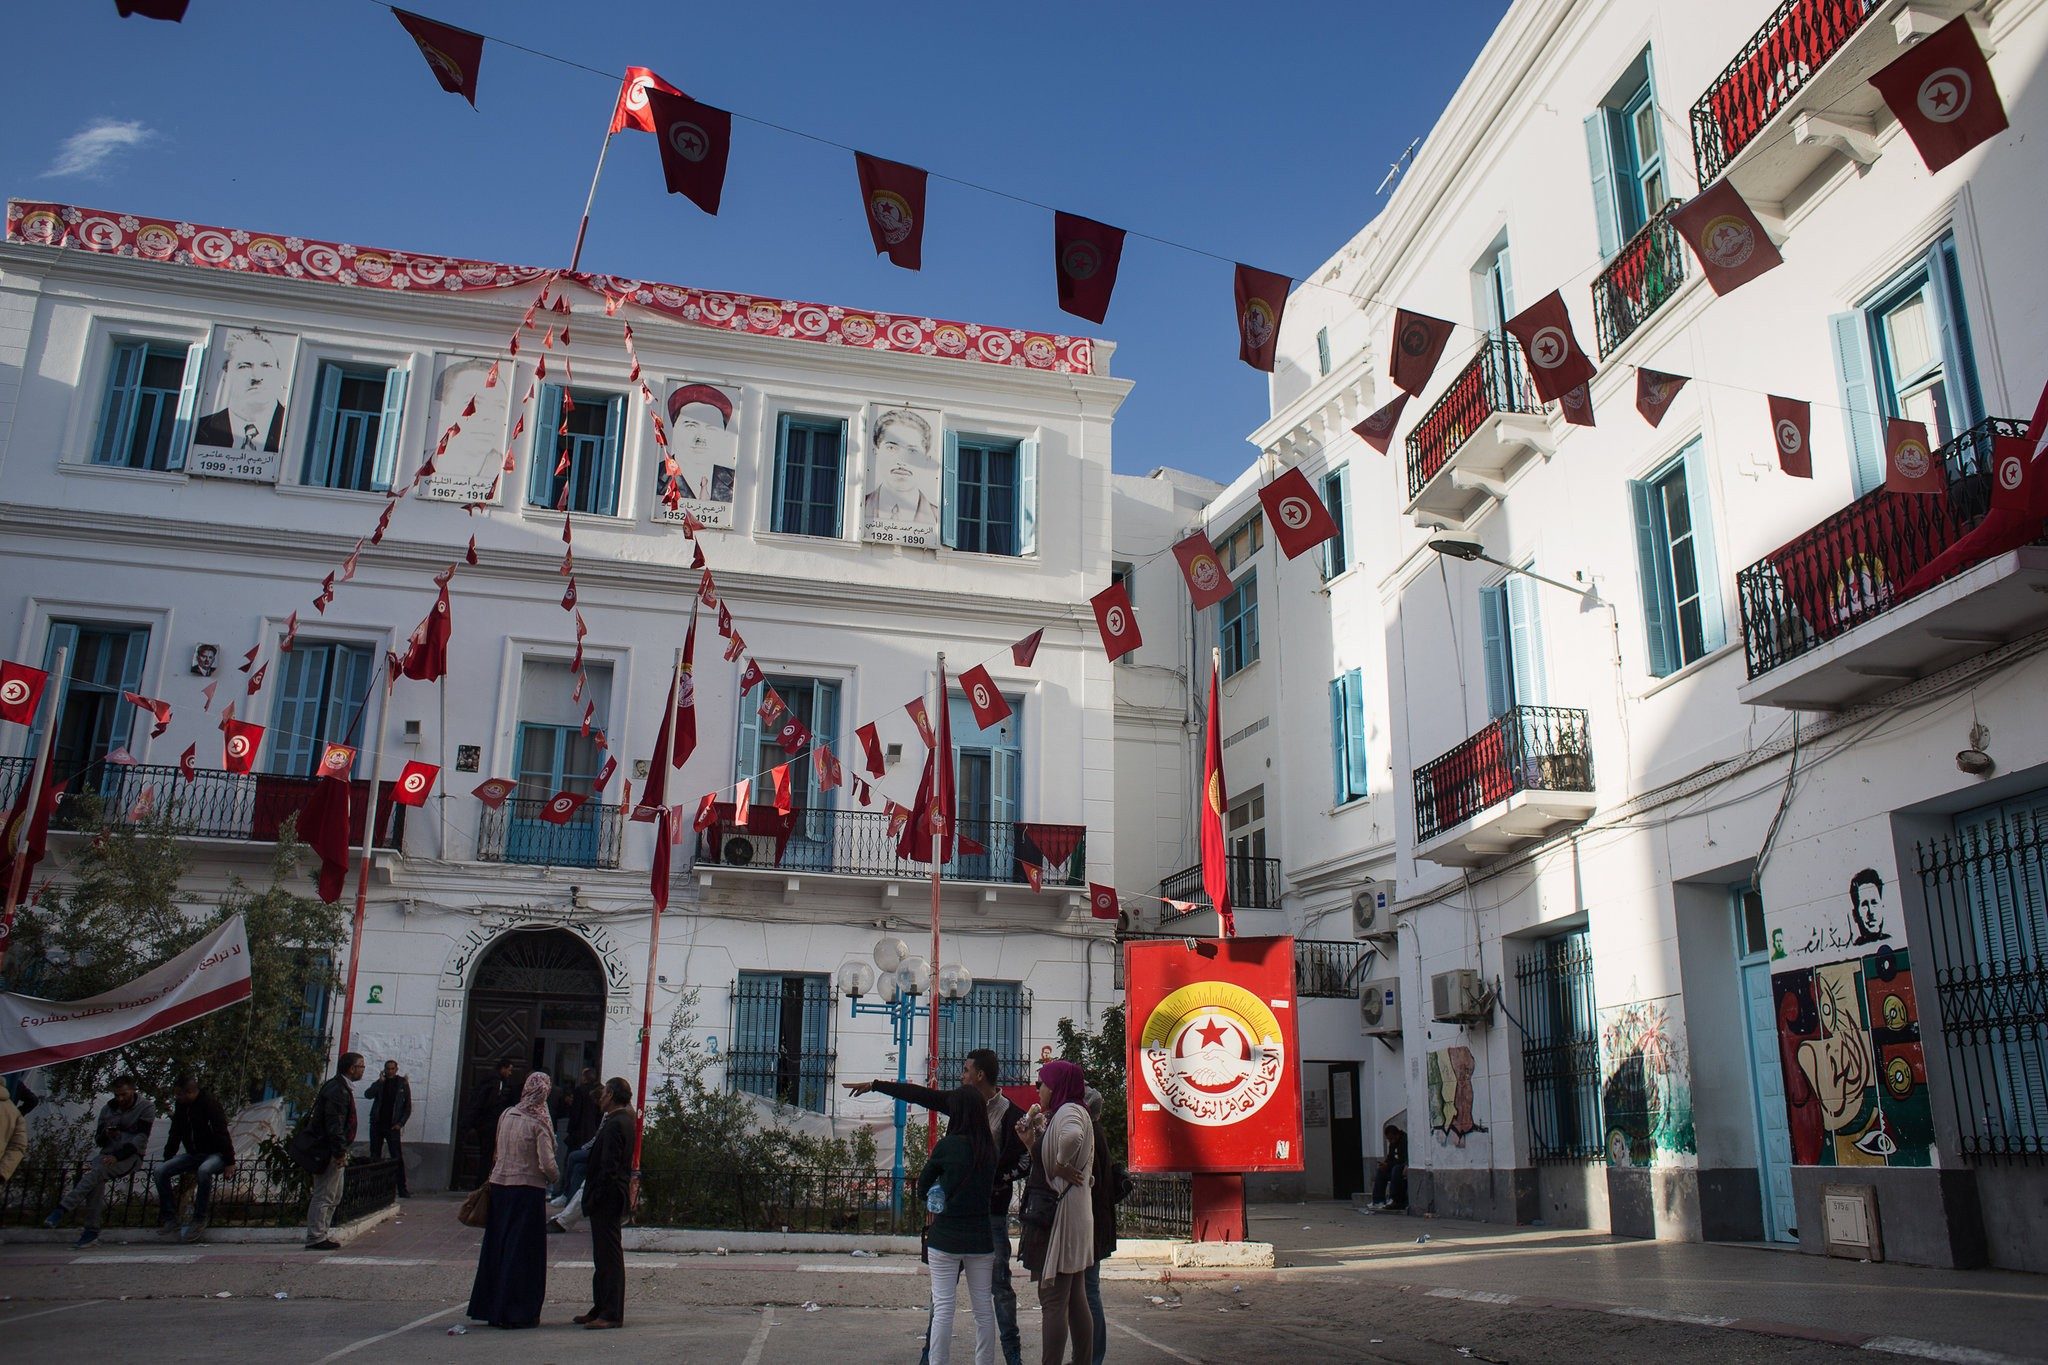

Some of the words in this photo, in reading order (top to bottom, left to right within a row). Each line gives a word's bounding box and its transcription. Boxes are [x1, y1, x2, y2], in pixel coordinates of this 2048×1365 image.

[247, 455, 274, 465] الزعيم
[200, 461, 226, 472] 1999
[237, 465, 262, 475] 1913
[432, 488, 456, 498] 1967
[702, 505, 726, 514] الزعيم
[663, 511, 686, 520] 1952
[696, 514, 719, 524] 1914
[914, 527, 933, 535] الزعيم
[871, 532, 893, 541] 1928
[902, 535, 925, 544] 1890
[232, 945, 241, 955] لا
[438, 999, 462, 1008] UGTT
[607, 1005, 631, 1014] UGTT
[21, 1012, 68, 1028] مشروع
